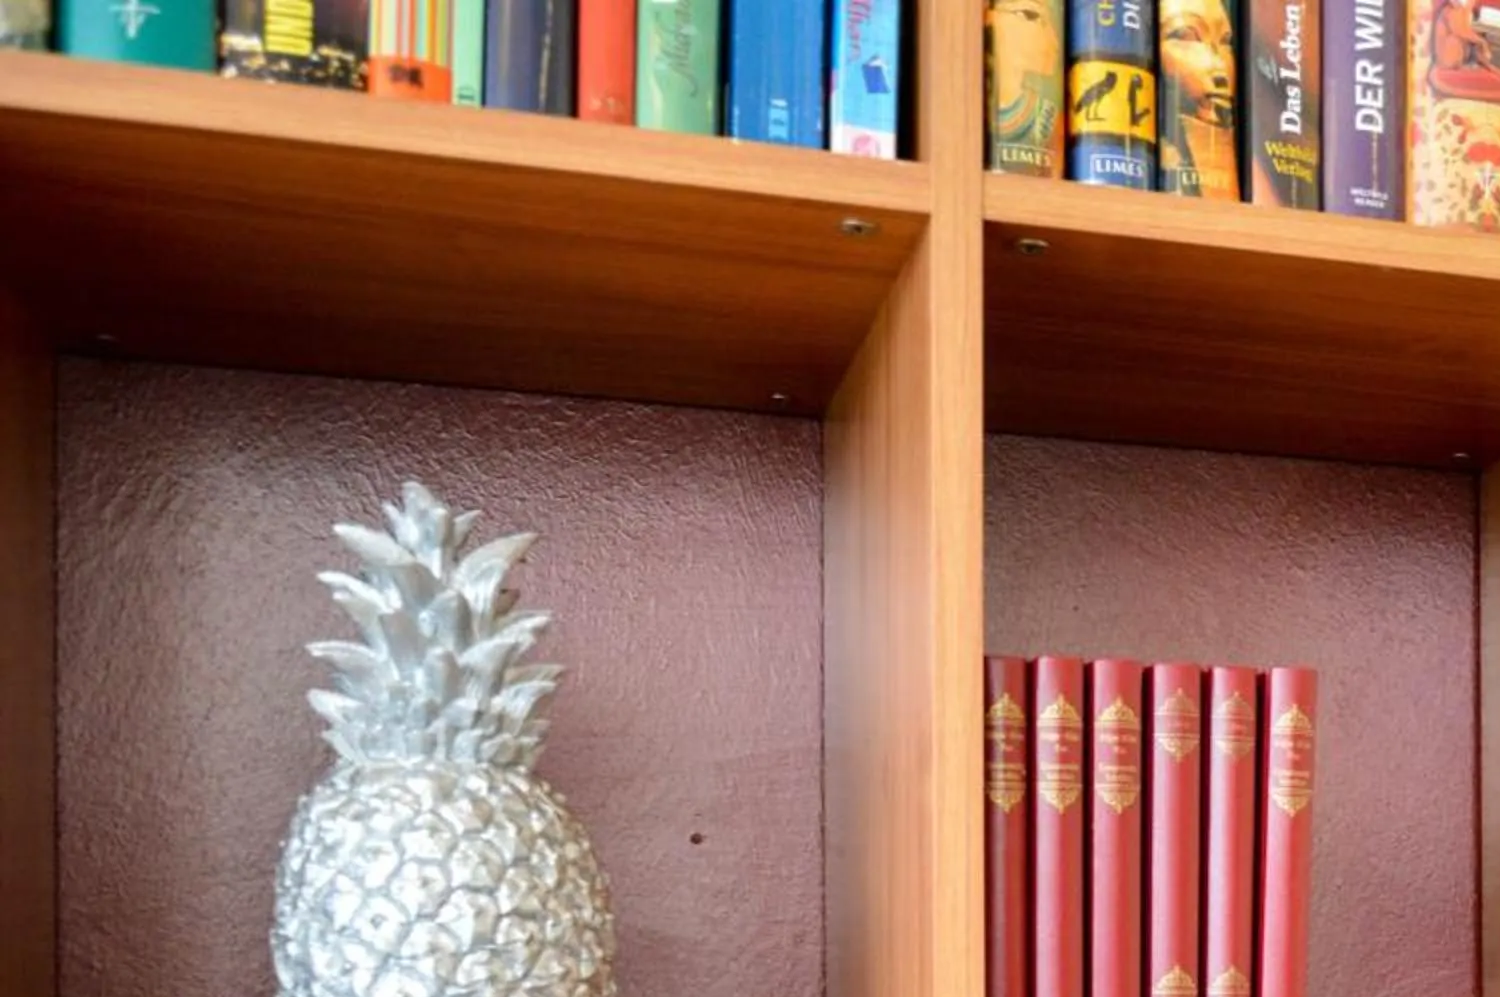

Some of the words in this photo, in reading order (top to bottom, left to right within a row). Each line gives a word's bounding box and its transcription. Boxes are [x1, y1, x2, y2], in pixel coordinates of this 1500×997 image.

[1279, 3, 1302, 81] Leben
[1279, 84, 1302, 135] Das
[1354, 58, 1384, 133] DER
[1001, 148, 1052, 168] LIMES
[1094, 157, 1145, 179] LIMES
[1264, 139, 1316, 168] Weltbild
[1271, 156, 1313, 183] Verlag
